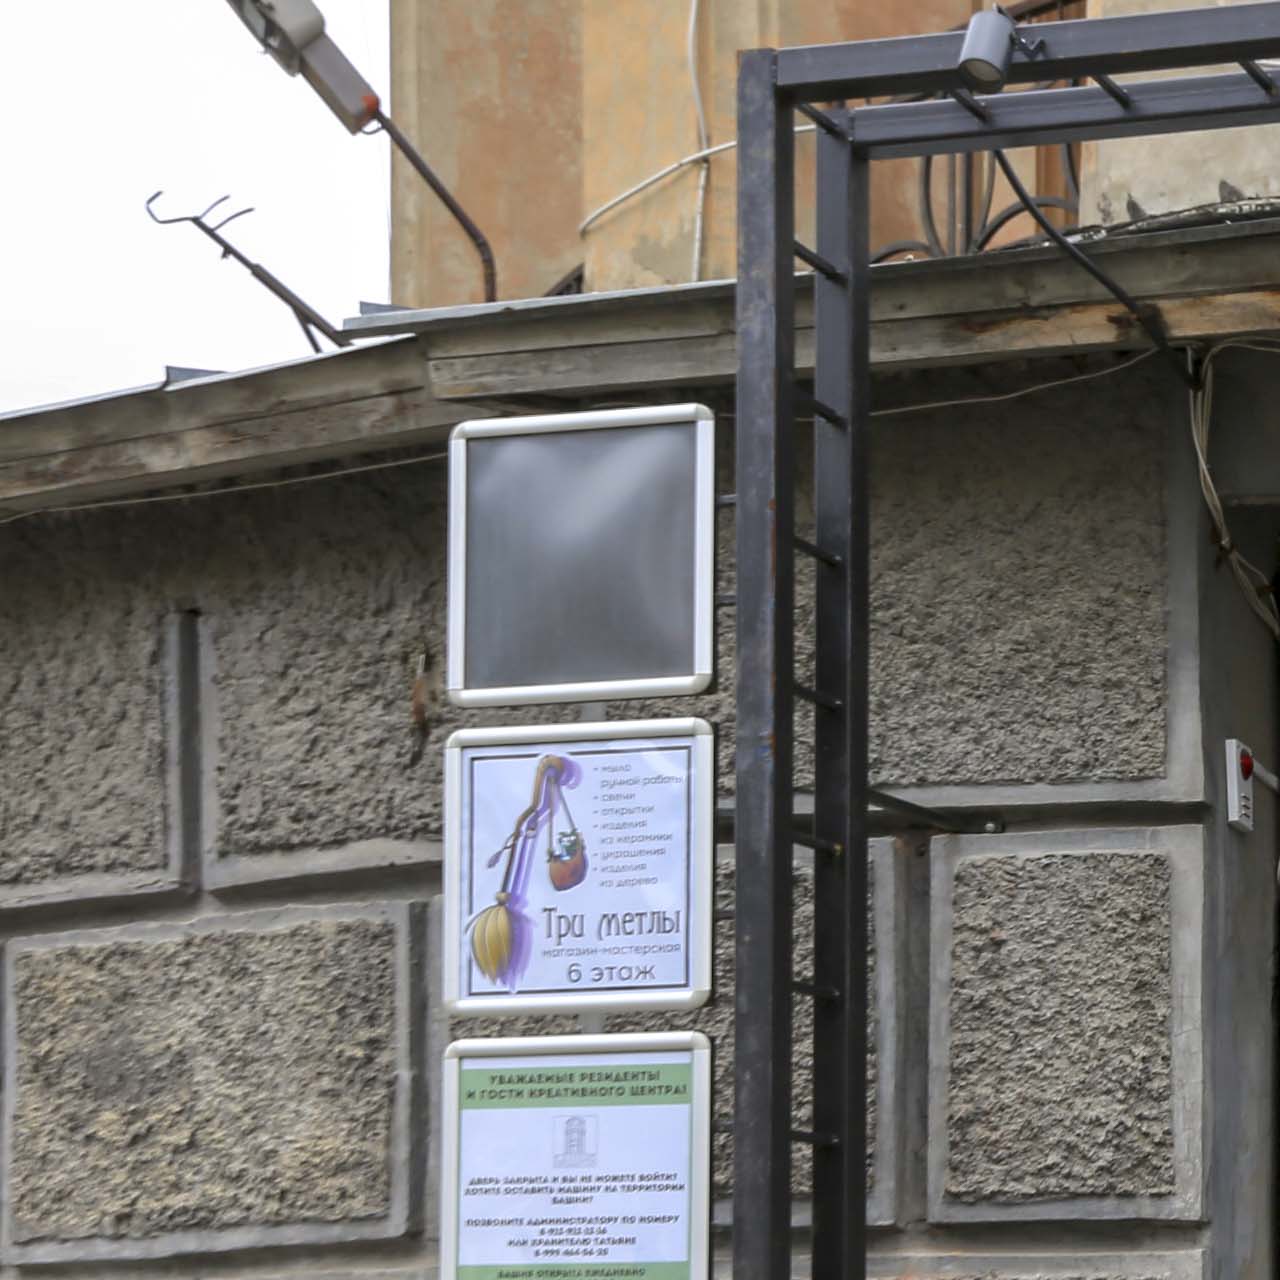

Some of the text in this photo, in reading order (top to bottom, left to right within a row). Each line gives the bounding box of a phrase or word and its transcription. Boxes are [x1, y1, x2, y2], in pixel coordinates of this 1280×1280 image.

[541, 906, 681, 946] Три метлы
[567, 962, 656, 983] 6 этаж
[489, 1071, 661, 1085] УВАЖАЕМЫЕ РЕЗИДЕНТЫ
[480, 1088, 524, 1100] ГОСТИ
[527, 1086, 626, 1099] КРЕАТИВНОГО
